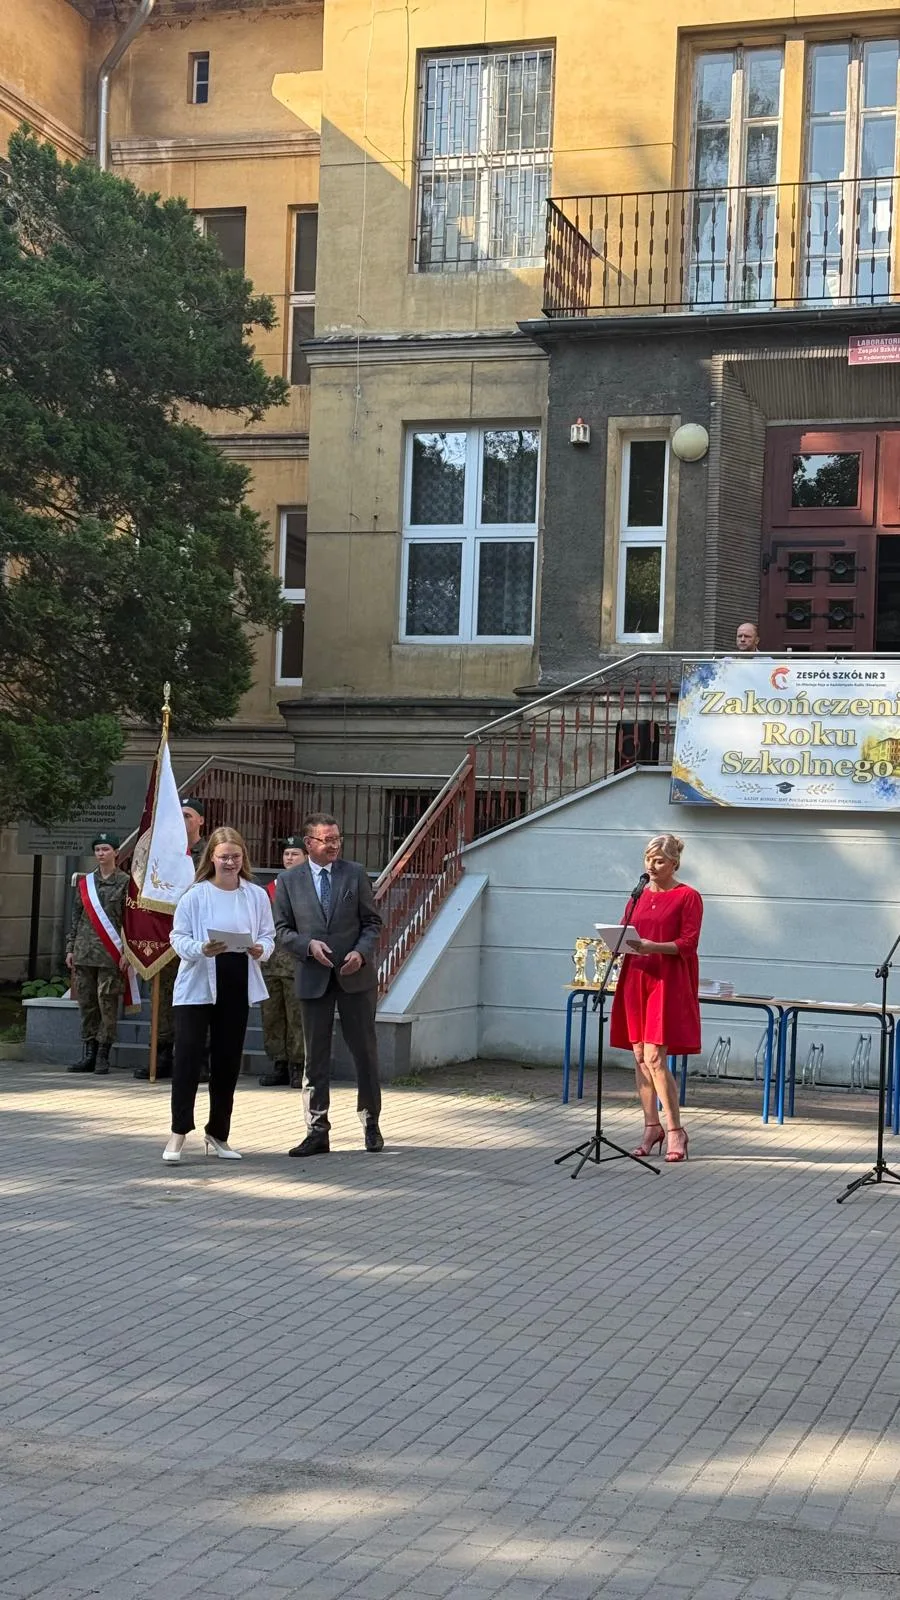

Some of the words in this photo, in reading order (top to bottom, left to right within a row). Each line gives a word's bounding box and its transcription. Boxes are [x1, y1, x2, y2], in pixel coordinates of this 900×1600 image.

[858, 346, 879, 355] Zespół
[796, 669, 831, 680] ZESPÓŁ
[833, 669, 864, 680] SZKÓŁ
[864, 671, 878, 680] NR
[879, 671, 886, 680] 3
[761, 721, 857, 746] Roku
[720, 750, 894, 783] Szkolnego
